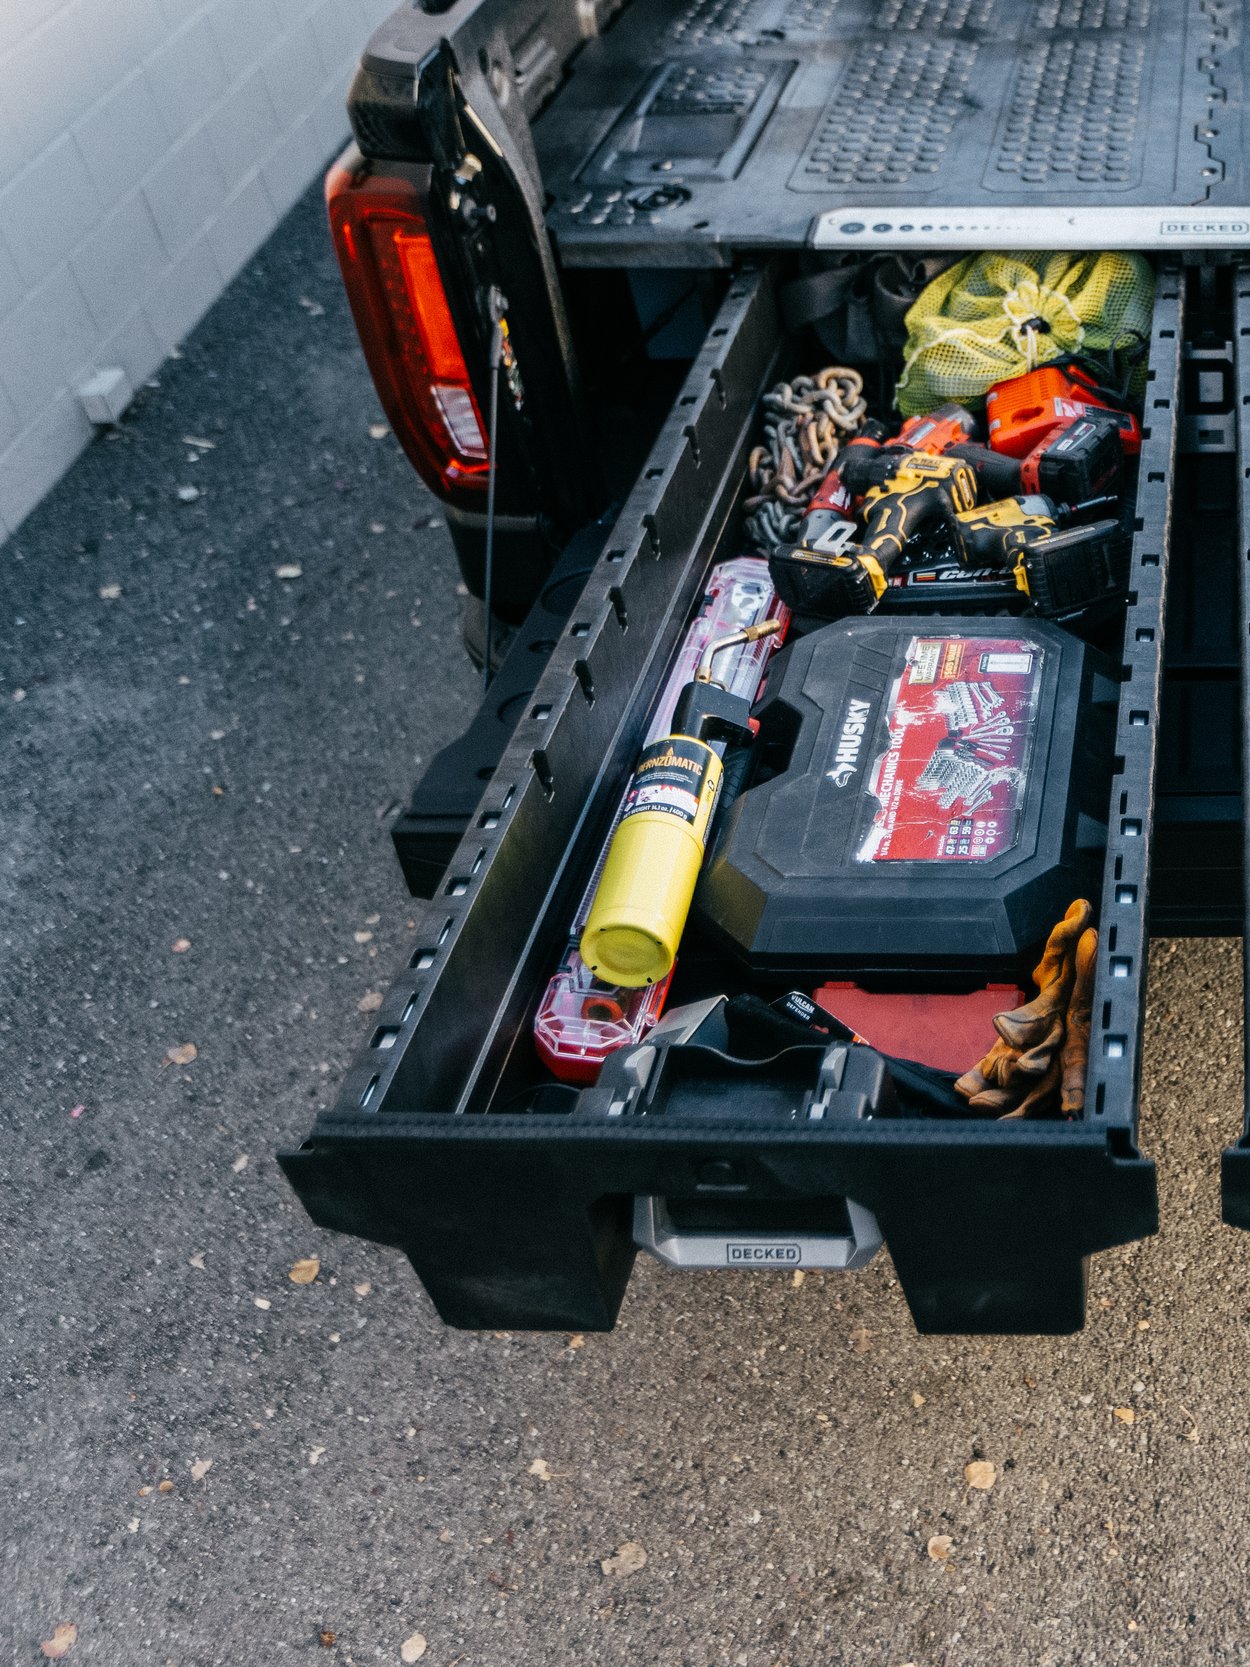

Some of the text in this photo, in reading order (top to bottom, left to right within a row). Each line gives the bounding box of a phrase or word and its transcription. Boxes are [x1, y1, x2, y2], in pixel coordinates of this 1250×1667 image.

[1166, 223, 1243, 232] DECKED
[915, 645, 930, 681] LIFETIME
[925, 645, 937, 680] WARRANTY
[835, 698, 871, 762] HUSKY
[637, 755, 703, 776] BERNZOMATIC
[880, 751, 900, 807] MECHANICS
[890, 726, 906, 750] TOOL
[894, 778, 904, 796] DRIVE
[785, 1001, 811, 1020] DEFENDER
[791, 994, 816, 1012] VULCAN
[732, 1248, 796, 1259] DECKED
